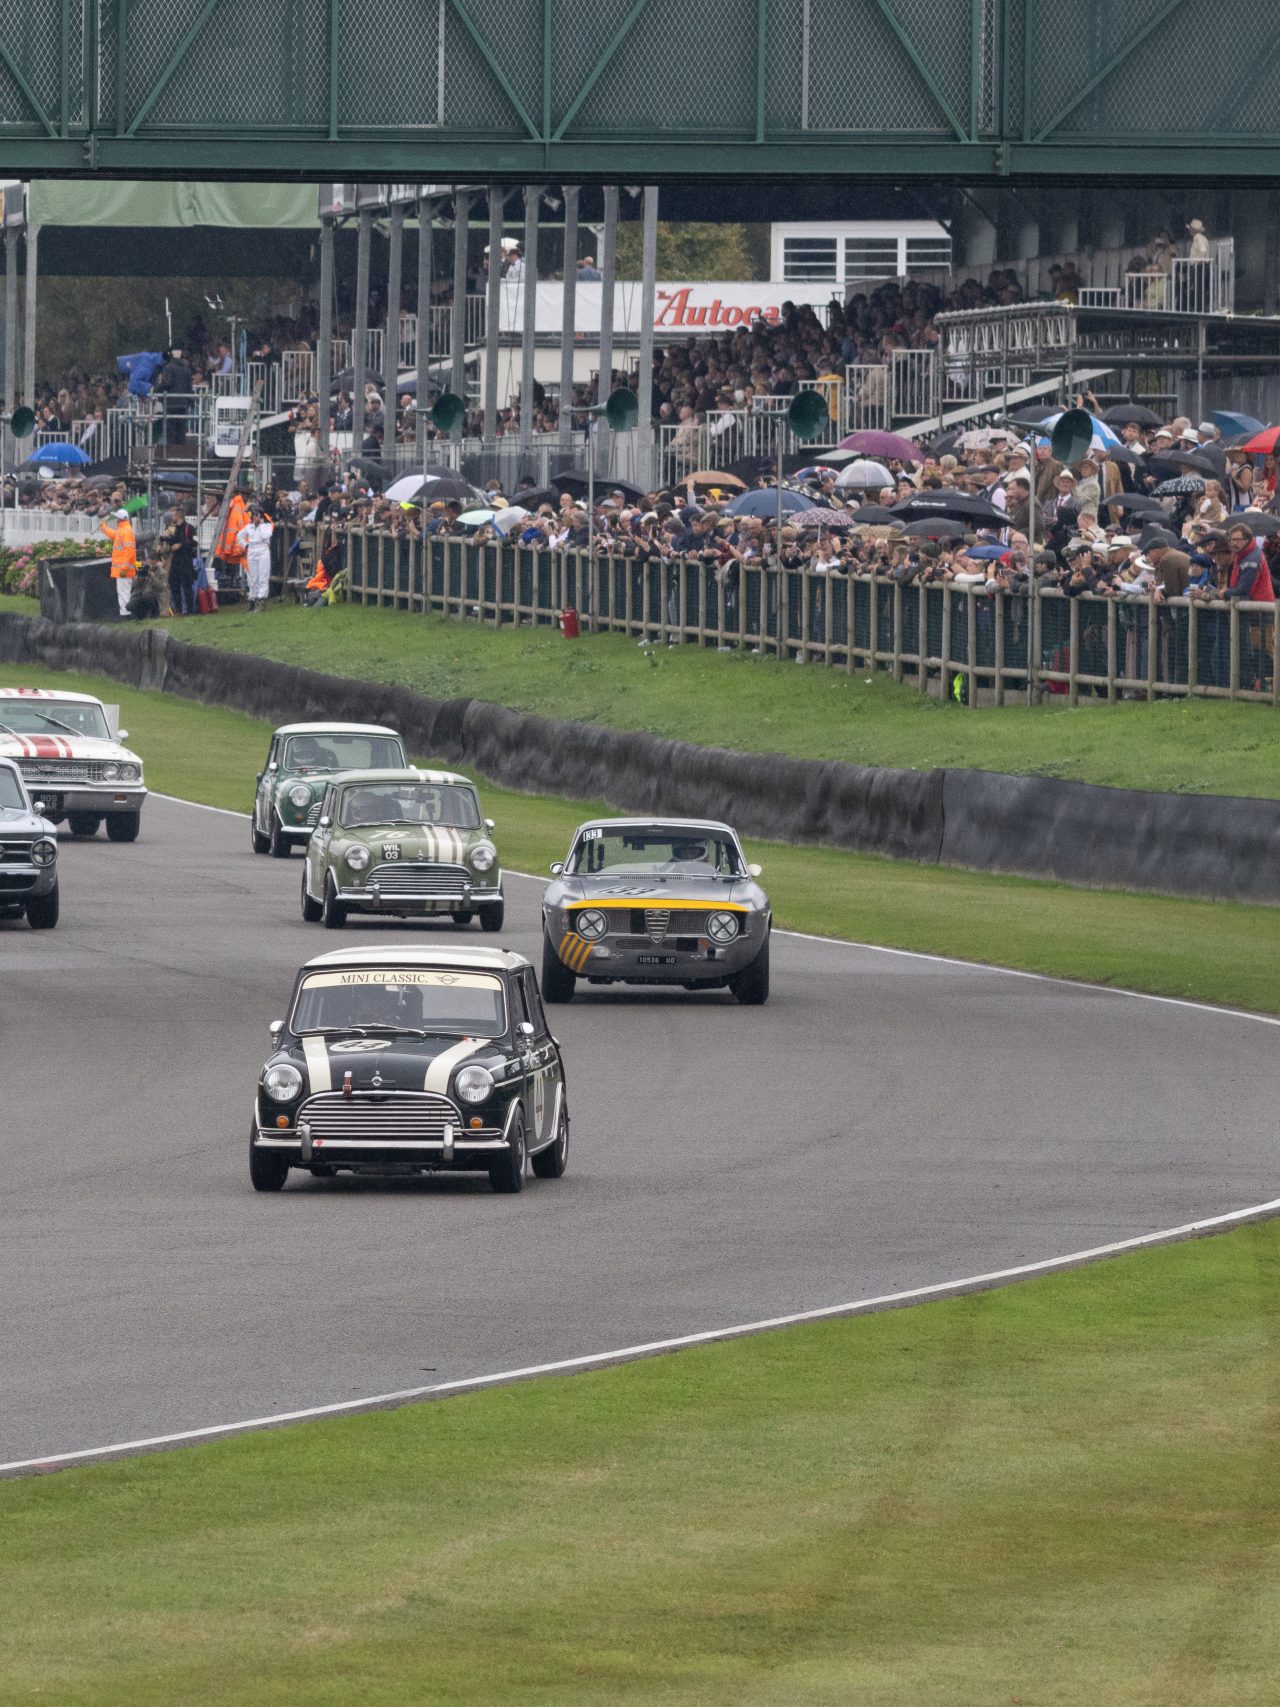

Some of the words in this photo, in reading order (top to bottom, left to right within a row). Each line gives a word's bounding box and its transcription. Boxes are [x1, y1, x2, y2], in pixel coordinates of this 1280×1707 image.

[654, 288, 780, 327] Autoca
[369, 830, 410, 839] 76
[383, 843, 401, 851] WIL
[385, 851, 399, 860] 03
[340, 974, 370, 984] MINI
